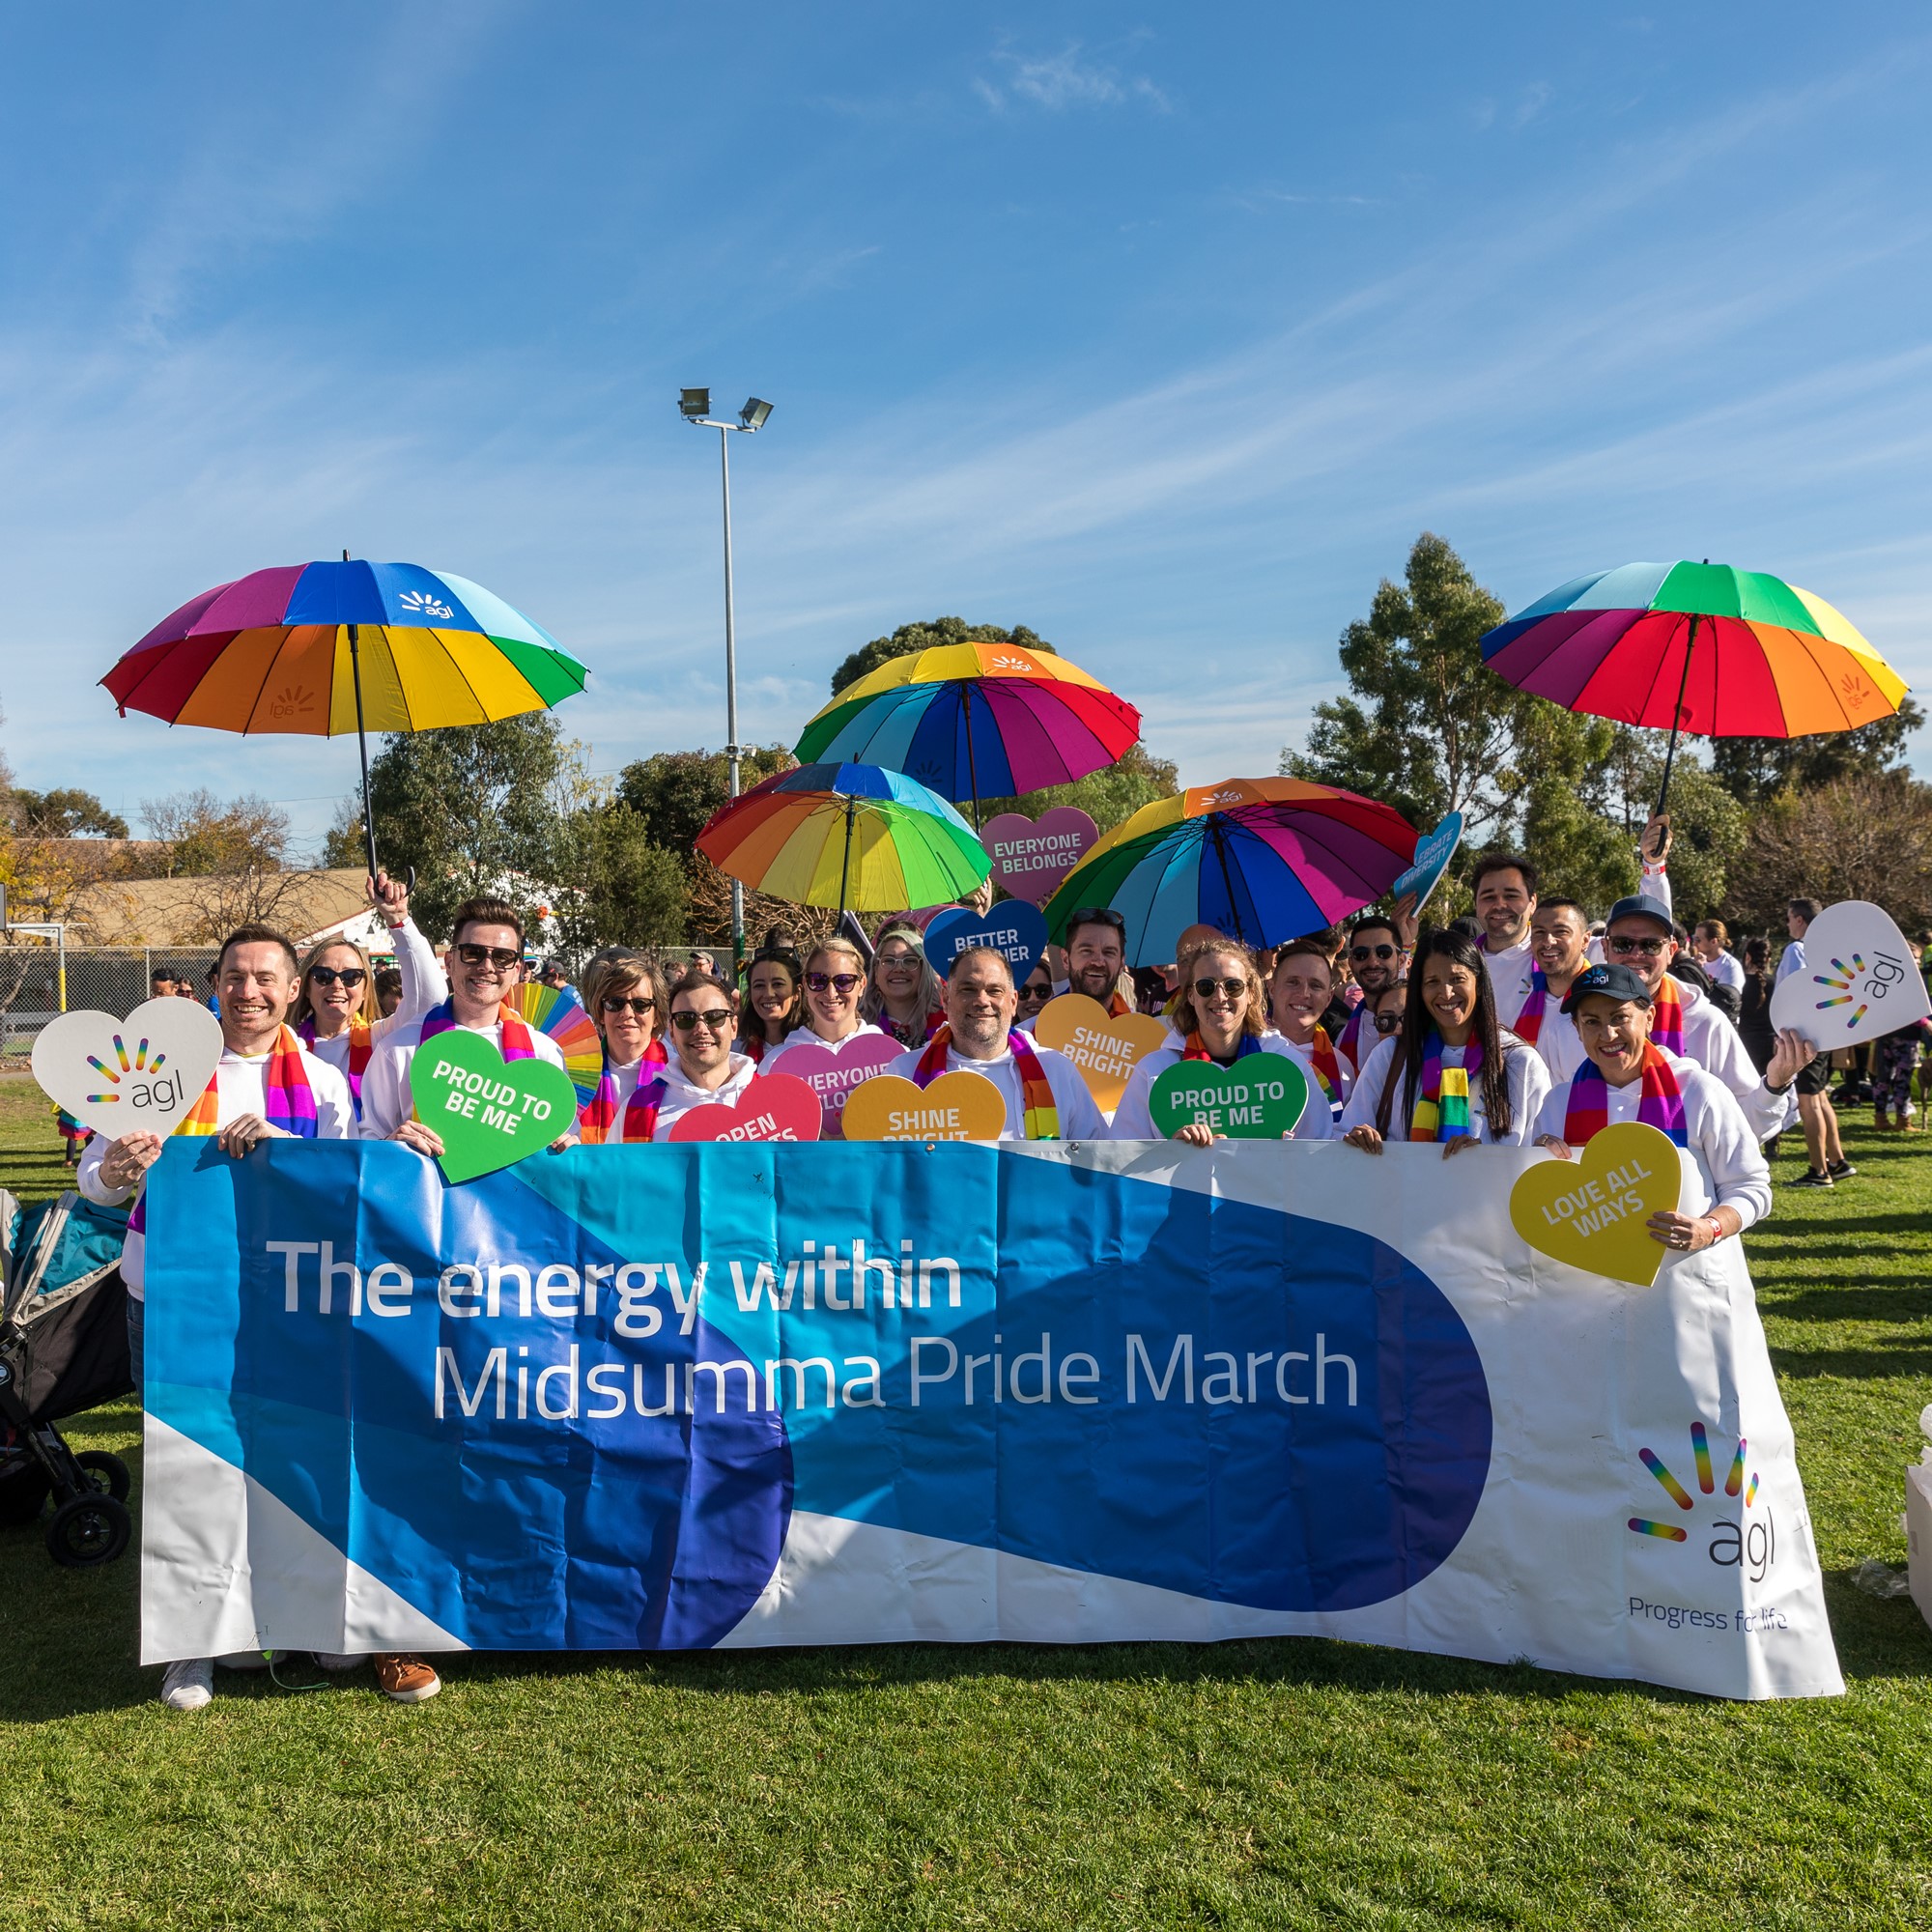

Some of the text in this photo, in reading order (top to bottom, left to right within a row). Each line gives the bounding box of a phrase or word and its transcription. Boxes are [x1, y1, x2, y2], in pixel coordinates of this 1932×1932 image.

[425, 606, 454, 619] agl
[994, 833, 1082, 858] EVERYONE
[1002, 851, 1078, 874] BELONGS
[1402, 843, 1449, 889] DIVERSITY
[954, 928, 1019, 952] BETTER
[1593, 974, 1609, 985] agl
[1864, 951, 1905, 999] agl
[1063, 1043, 1135, 1080] BRIGHT
[1072, 1026, 1135, 1060] SHINE
[131, 1068, 184, 1112] agl
[432, 1060, 552, 1121] PROUD TO
[1171, 1081, 1285, 1110] PROUD TO
[444, 1091, 523, 1135] BE ME
[889, 1108, 960, 1131] SHINE
[1194, 1105, 1264, 1128] BE ME
[1542, 1159, 1653, 1226] LOVE ALL
[1571, 1189, 1644, 1237] WAYS
[266, 1238, 962, 1339] The energy within
[435, 1332, 1358, 1420] Midsumma Pride March
[1709, 1506, 1776, 1583] agl
[1629, 1596, 1788, 1633] Progress for life
